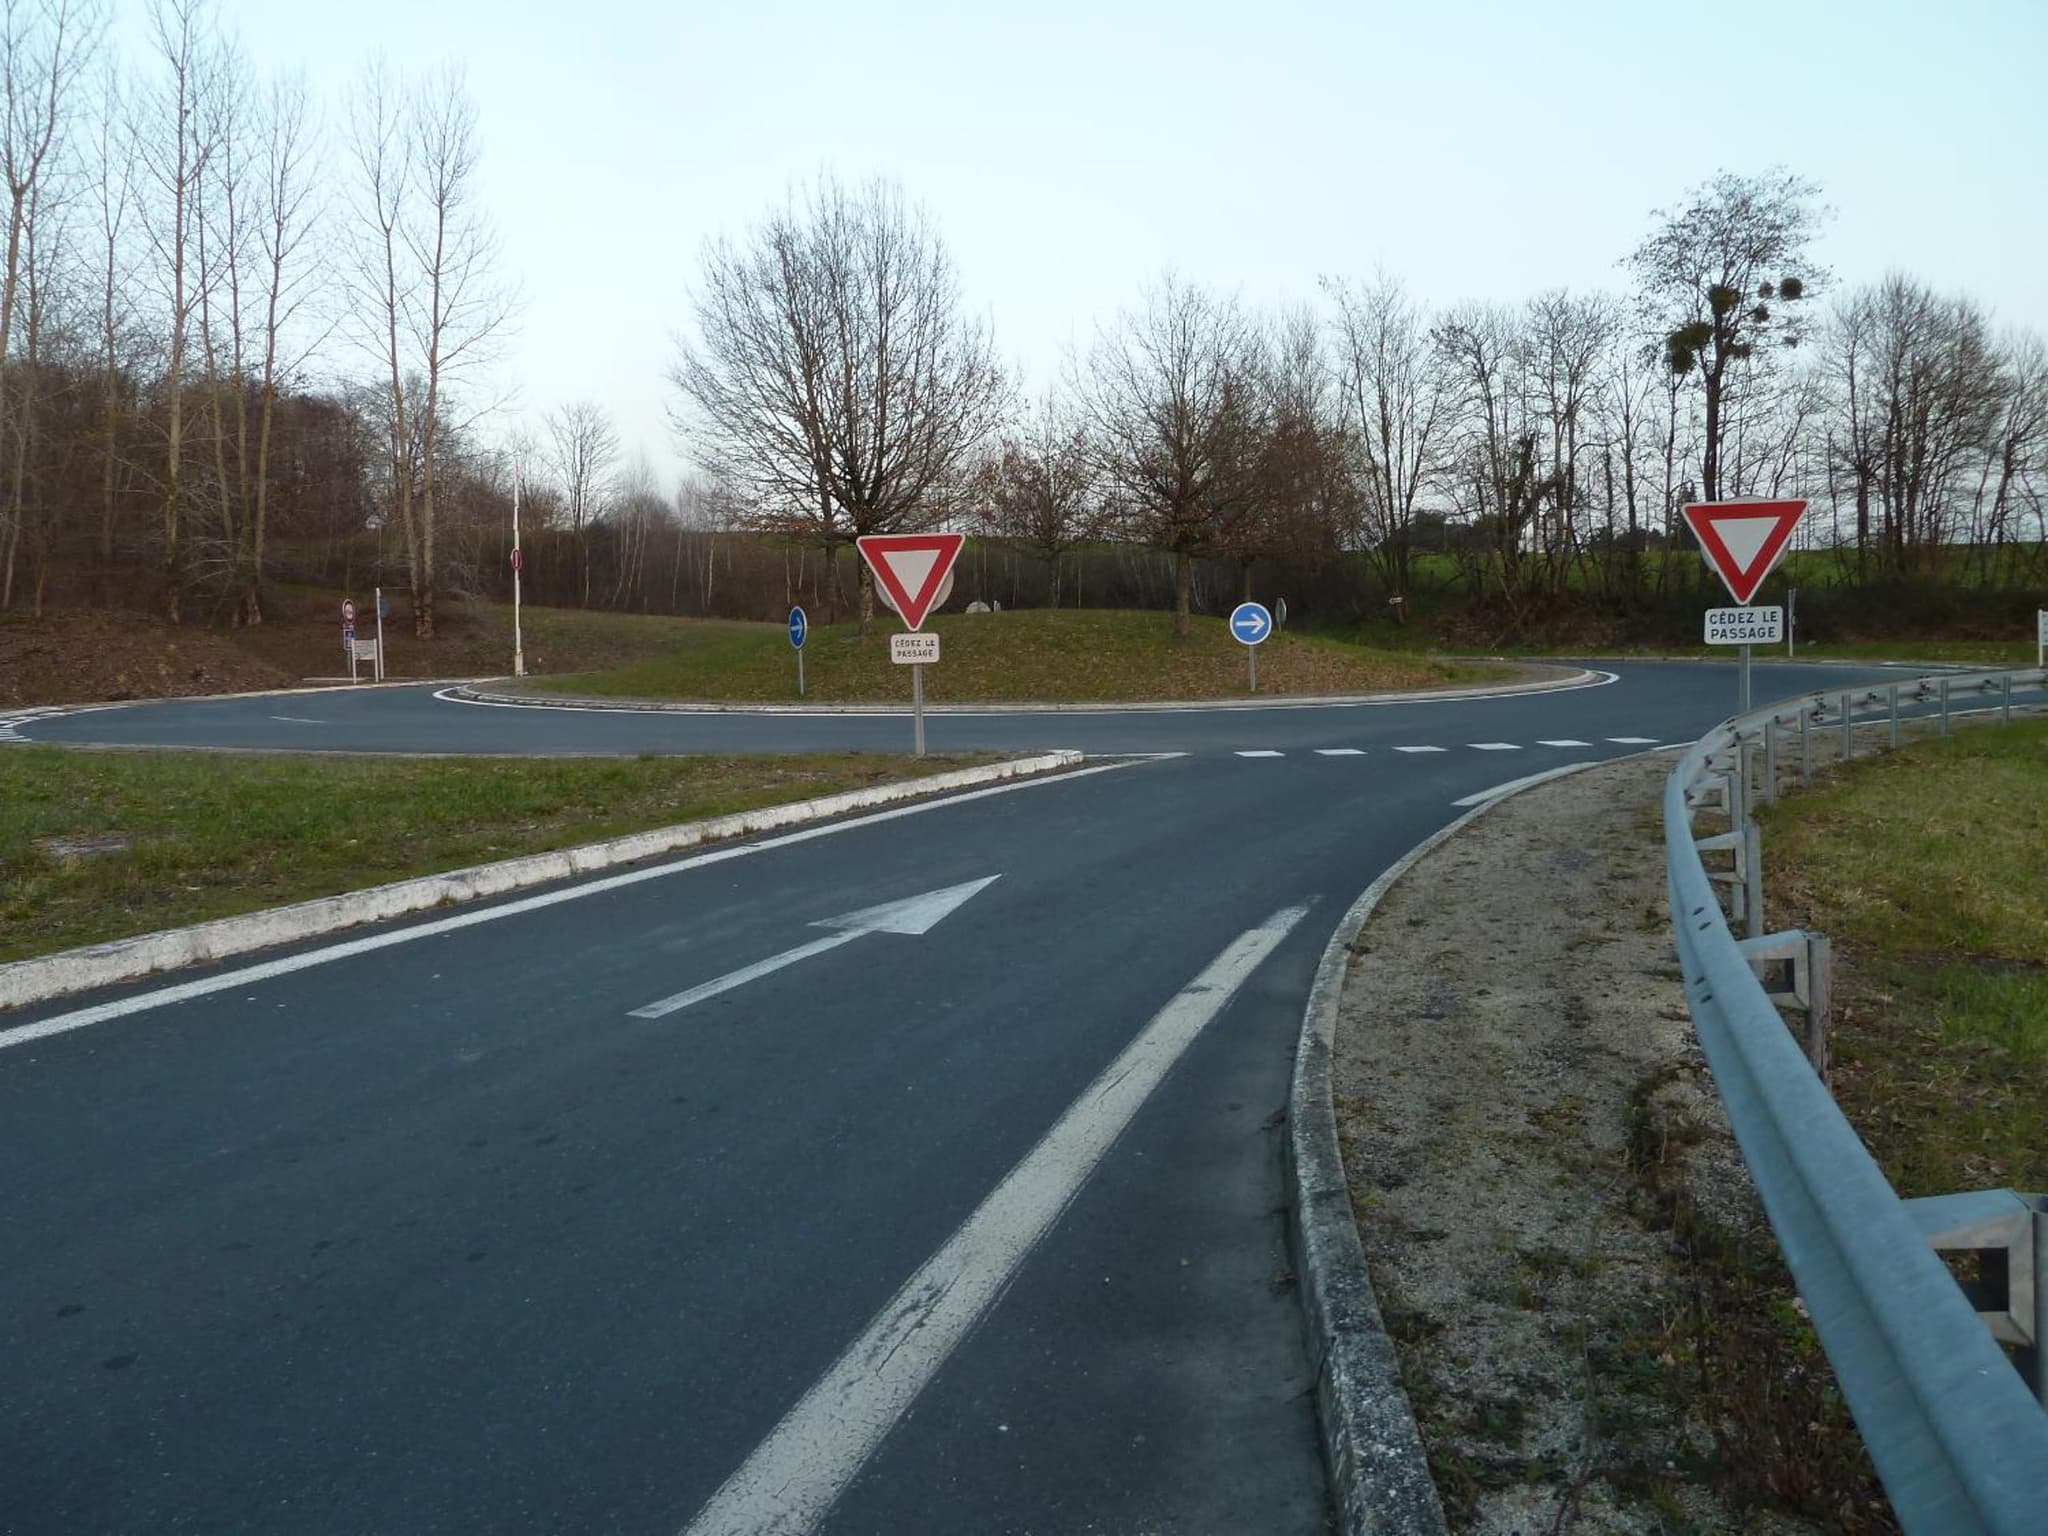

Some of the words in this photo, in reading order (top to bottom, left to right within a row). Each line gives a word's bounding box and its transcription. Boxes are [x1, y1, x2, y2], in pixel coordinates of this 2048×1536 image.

[1763, 611, 1777, 623] LE
[1711, 627, 1776, 639] PASSAGE
[896, 649, 934, 658] PASSAGE
